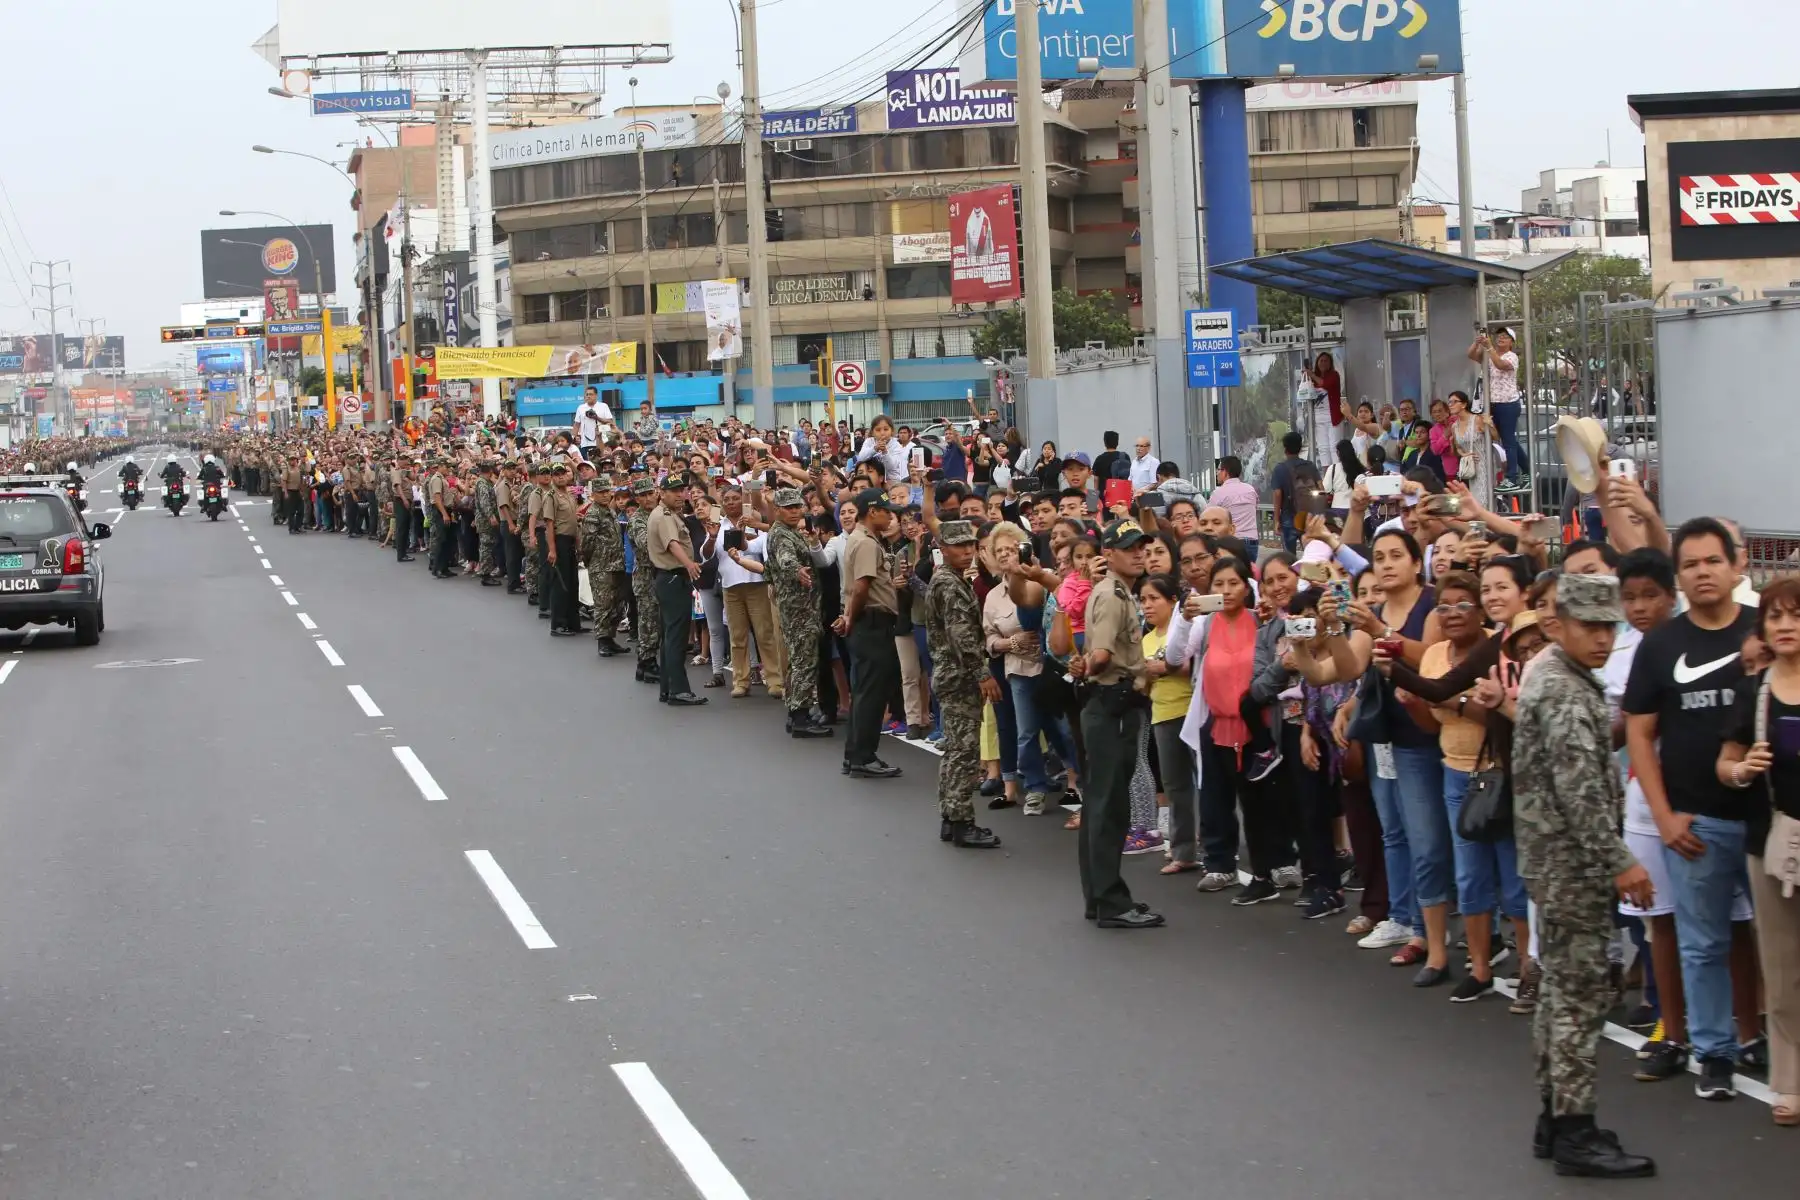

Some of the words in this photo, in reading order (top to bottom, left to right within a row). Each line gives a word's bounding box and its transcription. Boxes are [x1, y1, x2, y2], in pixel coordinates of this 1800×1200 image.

[1289, 0, 1398, 41] BCP
[917, 101, 1013, 123] LANDÁZURI
[761, 114, 852, 134] IRALDENT
[536, 133, 575, 155] Dental
[580, 130, 646, 149] Alemana
[1695, 191, 1705, 209] TGI
[1707, 188, 1794, 209] FRIDAYS
[775, 277, 846, 292] GIRALDENT
[769, 291, 813, 305] LINICA
[814, 289, 862, 302] DENTAL
[444, 270, 458, 347] NOTAR
[491, 349, 536, 359] Francisco!
[1192, 340, 1234, 351] PARADERO
[0, 578, 40, 591] LICIA
[1680, 689, 1720, 710] JUST
